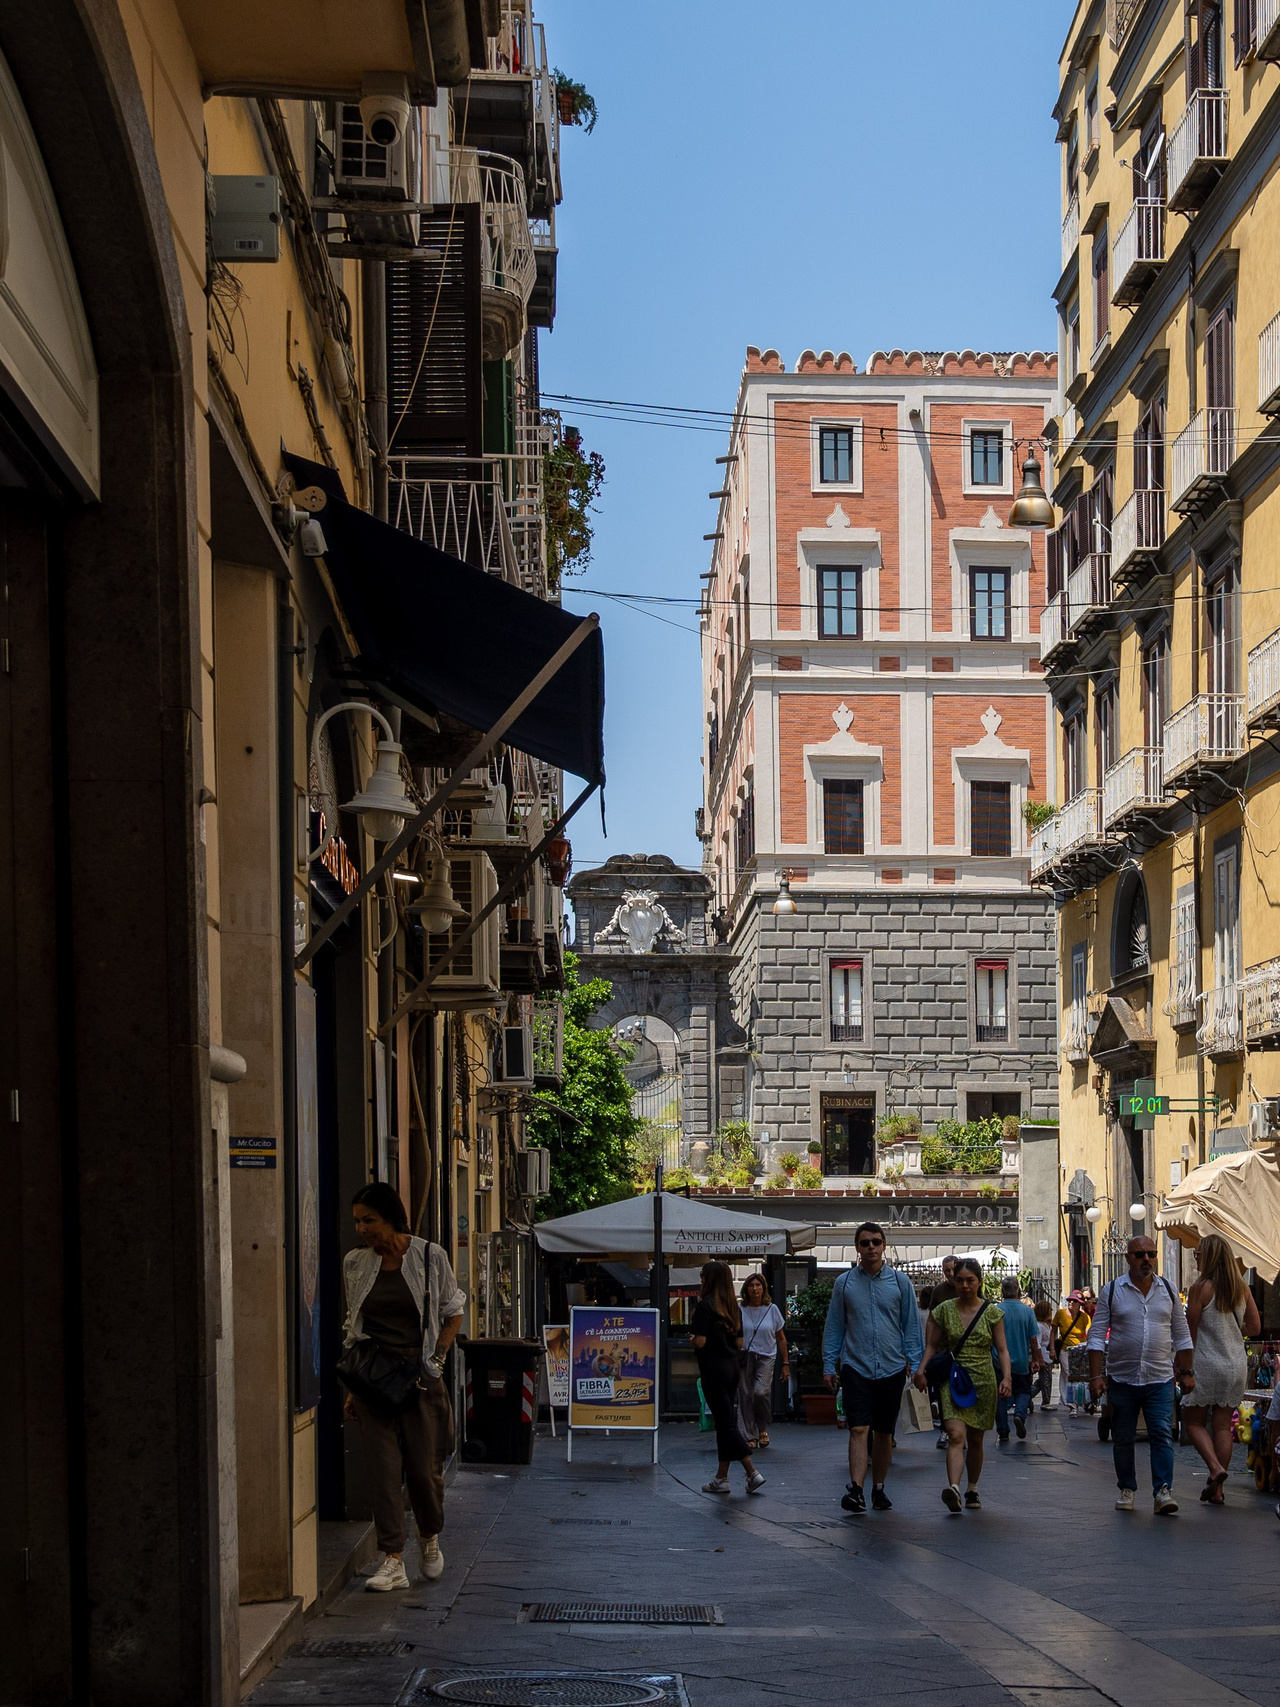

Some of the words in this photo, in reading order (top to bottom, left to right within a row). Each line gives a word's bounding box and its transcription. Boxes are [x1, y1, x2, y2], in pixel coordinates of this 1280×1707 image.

[822, 1096, 873, 1107] RUBINACCI
[1129, 1097, 1143, 1113] 12
[1147, 1097, 1161, 1113] 01
[676, 1229, 724, 1240] ANTICHI
[728, 1230, 770, 1242] SAPORI
[678, 1244, 767, 1254] PARTENOPEI
[603, 1318, 611, 1327] X
[612, 1317, 625, 1327] TE
[579, 1380, 611, 1390] FIBRA
[615, 1388, 648, 1399] 23,95€
[594, 1414, 632, 1422] FASTWEB
